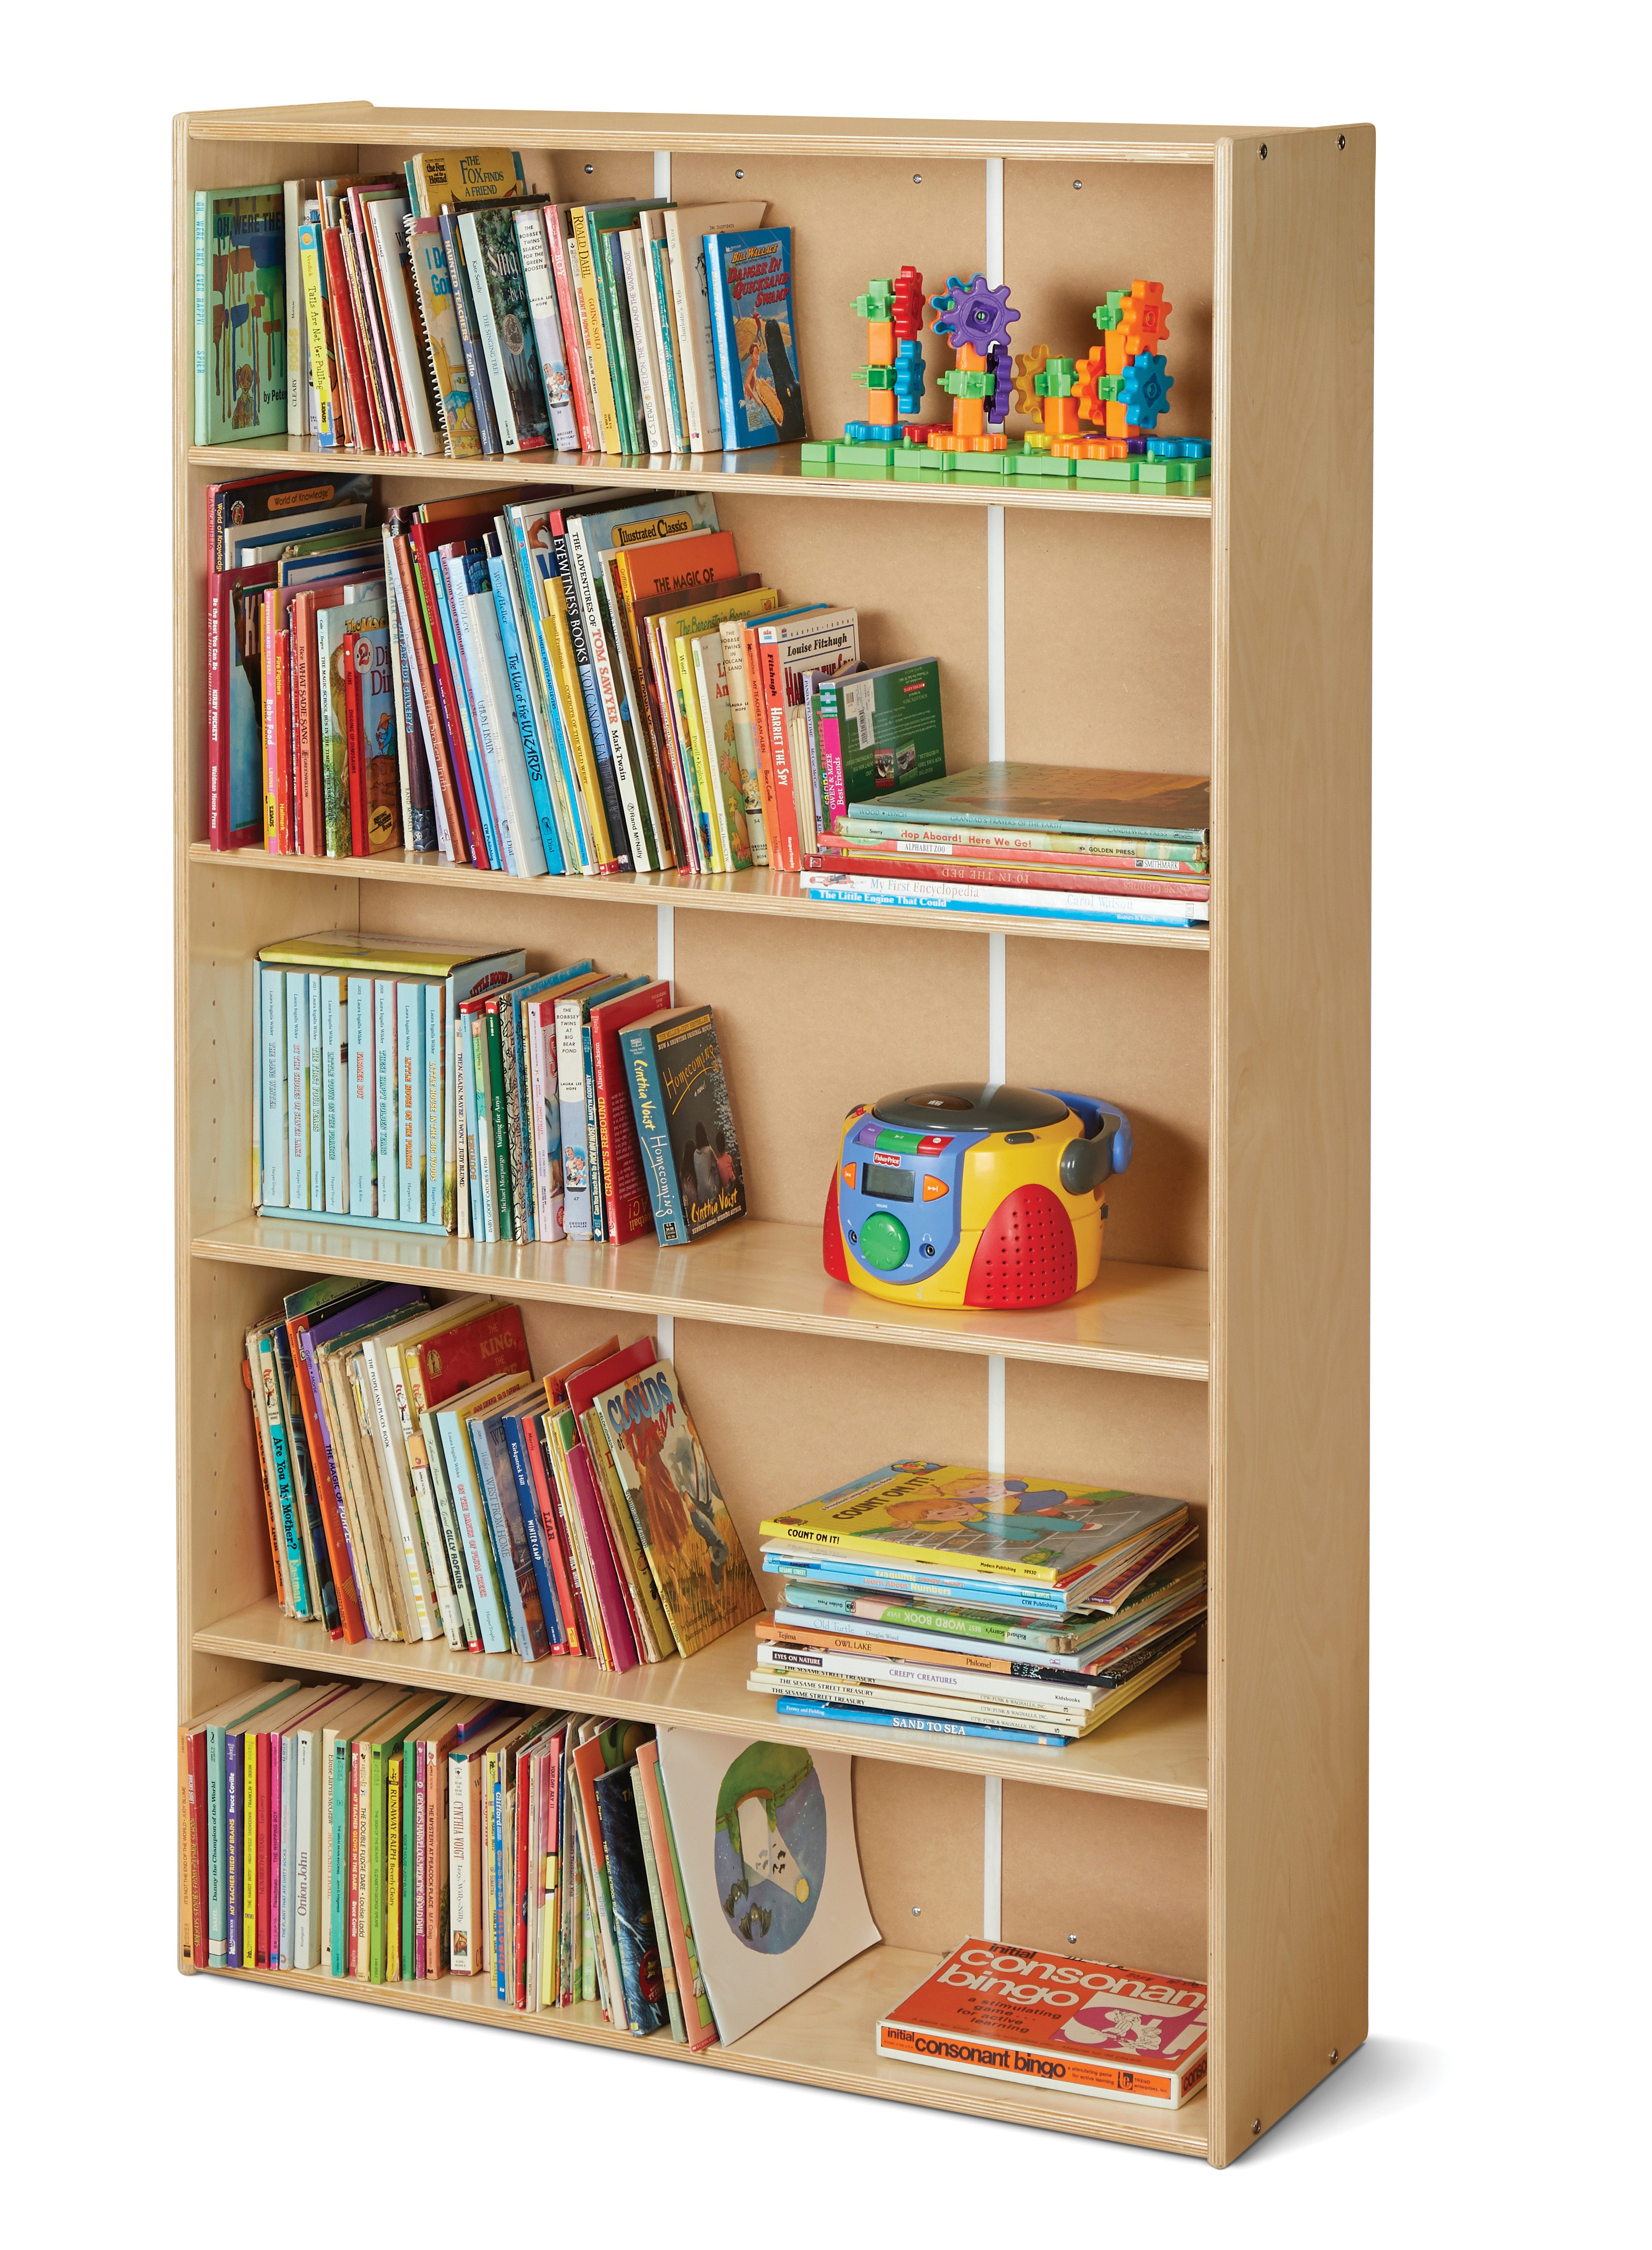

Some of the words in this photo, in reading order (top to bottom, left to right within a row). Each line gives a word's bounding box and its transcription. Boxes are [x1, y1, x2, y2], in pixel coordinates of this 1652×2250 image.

[460, 160, 484, 184] FOX
[483, 171, 504, 182] FINDS
[466, 156, 480, 166] THE
[465, 187, 471, 196] A
[472, 185, 497, 196] FRIEND
[519, 231, 542, 239] BOBBSEY
[573, 215, 587, 250] ROALD
[579, 251, 591, 278] DAHL
[731, 251, 746, 263] BILL
[748, 244, 778, 259] WALLACE
[727, 262, 767, 284] DANGER
[768, 257, 782, 273] IN
[733, 272, 789, 300] QUICKSAND
[755, 287, 789, 307] SWAMP
[588, 298, 598, 324] GOING
[485, 329, 496, 358] SINGING
[592, 325, 601, 349] SOLO
[316, 360, 325, 389] Pulling
[274, 495, 290, 505] World
[572, 532, 581, 551] THE
[618, 525, 656, 547] Illustrated
[657, 519, 688, 538] Classics
[576, 553, 594, 613] ADVENTURES
[654, 577, 671, 593] THE
[673, 572, 700, 589] MAGIC
[702, 568, 714, 582] OF
[554, 538, 578, 616] EYEWITNESS
[571, 620, 587, 663] BOOKS
[588, 614, 596, 627] OF
[592, 629, 606, 662] TOM
[787, 643, 812, 656] Louise
[814, 633, 847, 651] Fitzhugh
[768, 653, 776, 697] Fitzhugh
[599, 667, 618, 724] SAWYER
[771, 707, 784, 747] HARRIET
[611, 729, 621, 752] Mark
[616, 753, 626, 781] Twain
[776, 749, 785, 766] THE
[778, 767, 788, 786] SPY
[629, 811, 637, 831] Rand
[633, 833, 642, 858] McNally
[901, 830, 920, 839] Hop
[923, 832, 962, 842] Aboard!
[969, 836, 991, 845] Here
[994, 837, 1010, 846] We
[1014, 839, 1032, 848] Go!
[904, 842, 933, 852] ALPHABET
[933, 845, 945, 853] ZOO
[1144, 860, 1178, 870] SMITHMARK
[634, 1060, 650, 1099] Cynthia
[663, 1044, 719, 1099] Homecoming
[598, 1097, 609, 1148] REBOUND
[641, 1101, 656, 1131] Voigt
[875, 1155, 899, 1164] Fisher-Price
[602, 1151, 612, 1197] CRANE'S
[650, 1135, 675, 1218] Homecoming
[691, 1199, 718, 1223] Cynthia
[719, 1187, 738, 1207] Voigt
[370, 1371, 378, 1392] PEOPLE
[607, 1371, 673, 1434] CLOUDS
[273, 1437, 283, 1457] Are
[617, 1434, 624, 1451] of
[277, 1460, 285, 1480] You
[279, 1483, 289, 1500] My
[282, 1504, 297, 1550] Mother?
[543, 1512, 555, 1541] LIAR
[788, 1529, 814, 1540] COUNT
[816, 1533, 828, 1542] ON
[829, 1535, 840, 1544] IT!
[778, 1632, 796, 1640] Tejima
[835, 1640, 853, 1649] OWL
[853, 1642, 872, 1651] LAKE
[799, 1656, 820, 1665] NATURE
[966, 1658, 991, 1669] Philomel
[793, 1679, 817, 1688] SESAME
[818, 1683, 841, 1691] STREET
[842, 1686, 874, 1696] TREASURY
[889, 1669, 915, 1678] CREEPY
[917, 1673, 957, 1685] CREATURES
[893, 1718, 925, 1730] SAND
[926, 1721, 942, 1733] TO
[943, 1724, 966, 1736] SEA
[454, 1801, 464, 1834] CYNTHIA
[454, 1837, 464, 1860] VOIGT
[298, 1851, 307, 1880] John
[298, 1882, 307, 1916] Onion
[989, 1943, 1038, 1960] initial
[937, 1964, 1080, 2007] bingo
[887, 2027, 915, 2042] initial
[915, 2037, 1010, 2068] consonant
[1014, 2050, 1066, 2078] bingo
